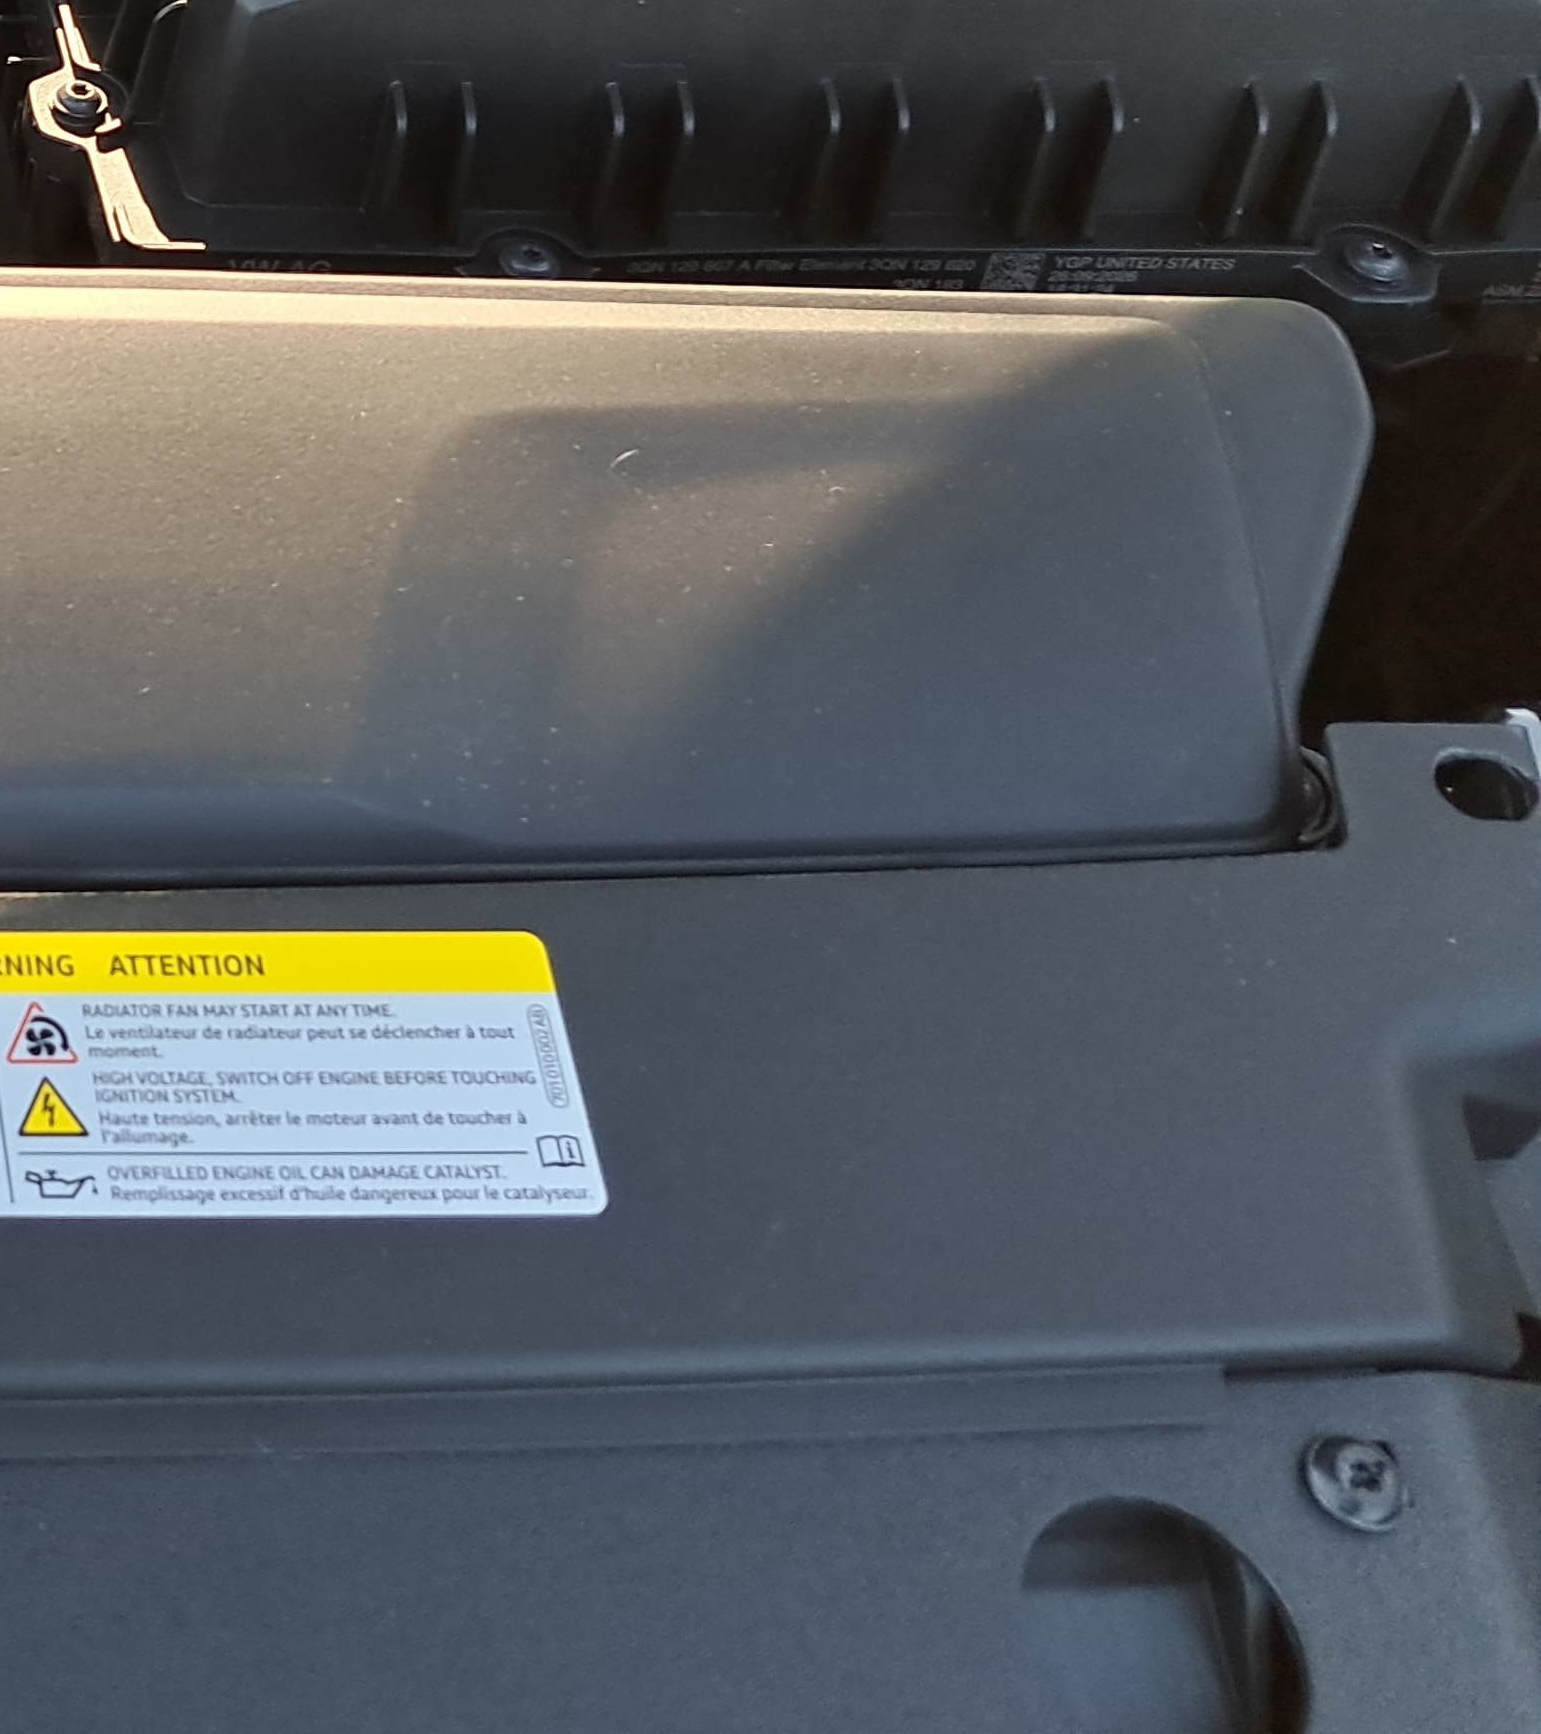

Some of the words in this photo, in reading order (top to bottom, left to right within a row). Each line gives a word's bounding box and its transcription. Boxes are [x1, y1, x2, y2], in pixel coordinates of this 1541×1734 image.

[1096, 256, 1160, 269] UNITED
[1165, 257, 1237, 271] STATES
[110, 954, 265, 977] ATTENTION
[81, 1003, 162, 1018] RADIATOR
[166, 1004, 199, 1018] FAN
[202, 1004, 238, 1018] MAY
[240, 1004, 289, 1019] START
[293, 1003, 312, 1017] AT
[316, 1004, 348, 1018] ANY
[84, 1025, 105, 1040] Le
[108, 1025, 198, 1040] ventilateur
[201, 1025, 223, 1041] de
[227, 1025, 302, 1040] radiateur
[306, 1027, 346, 1043] peut
[348, 1028, 368, 1040] se
[371, 1024, 461, 1040] déclencher
[465, 1024, 476, 1039] à
[478, 1026, 515, 1039] tout
[87, 1045, 164, 1059] moment.
[91, 1070, 134, 1086] HIGH
[215, 1071, 280, 1086] SWITCH
[282, 1070, 314, 1086] OFF
[317, 1071, 380, 1086] ENGINE
[383, 1070, 448, 1086] BEFORE
[450, 1069, 539, 1085] TOUCHING
[94, 1088, 170, 1104] IGNITION
[172, 1088, 242, 1104] SYSTEM.
[97, 1111, 149, 1127] Haute
[225, 1110, 282, 1126] arrêter
[285, 1110, 302, 1126] le
[305, 1113, 367, 1126] moteur
[371, 1113, 420, 1126] avant
[422, 1111, 445, 1126] de
[447, 1110, 512, 1125] toucher
[517, 1110, 528, 1125] à
[106, 1165, 209, 1181] OVERFILLED
[211, 1165, 275, 1181] ENGINE
[278, 1165, 309, 1182] OIL
[309, 1165, 345, 1180] CAN
[348, 1165, 421, 1181] DAMAGE
[110, 1185, 216, 1206] Remplissage
[219, 1185, 285, 1202] excessif
[289, 1185, 346, 1201] d'huile
[349, 1186, 439, 1205] dangereux
[441, 1188, 480, 1204] pour
[482, 1184, 500, 1201] le
